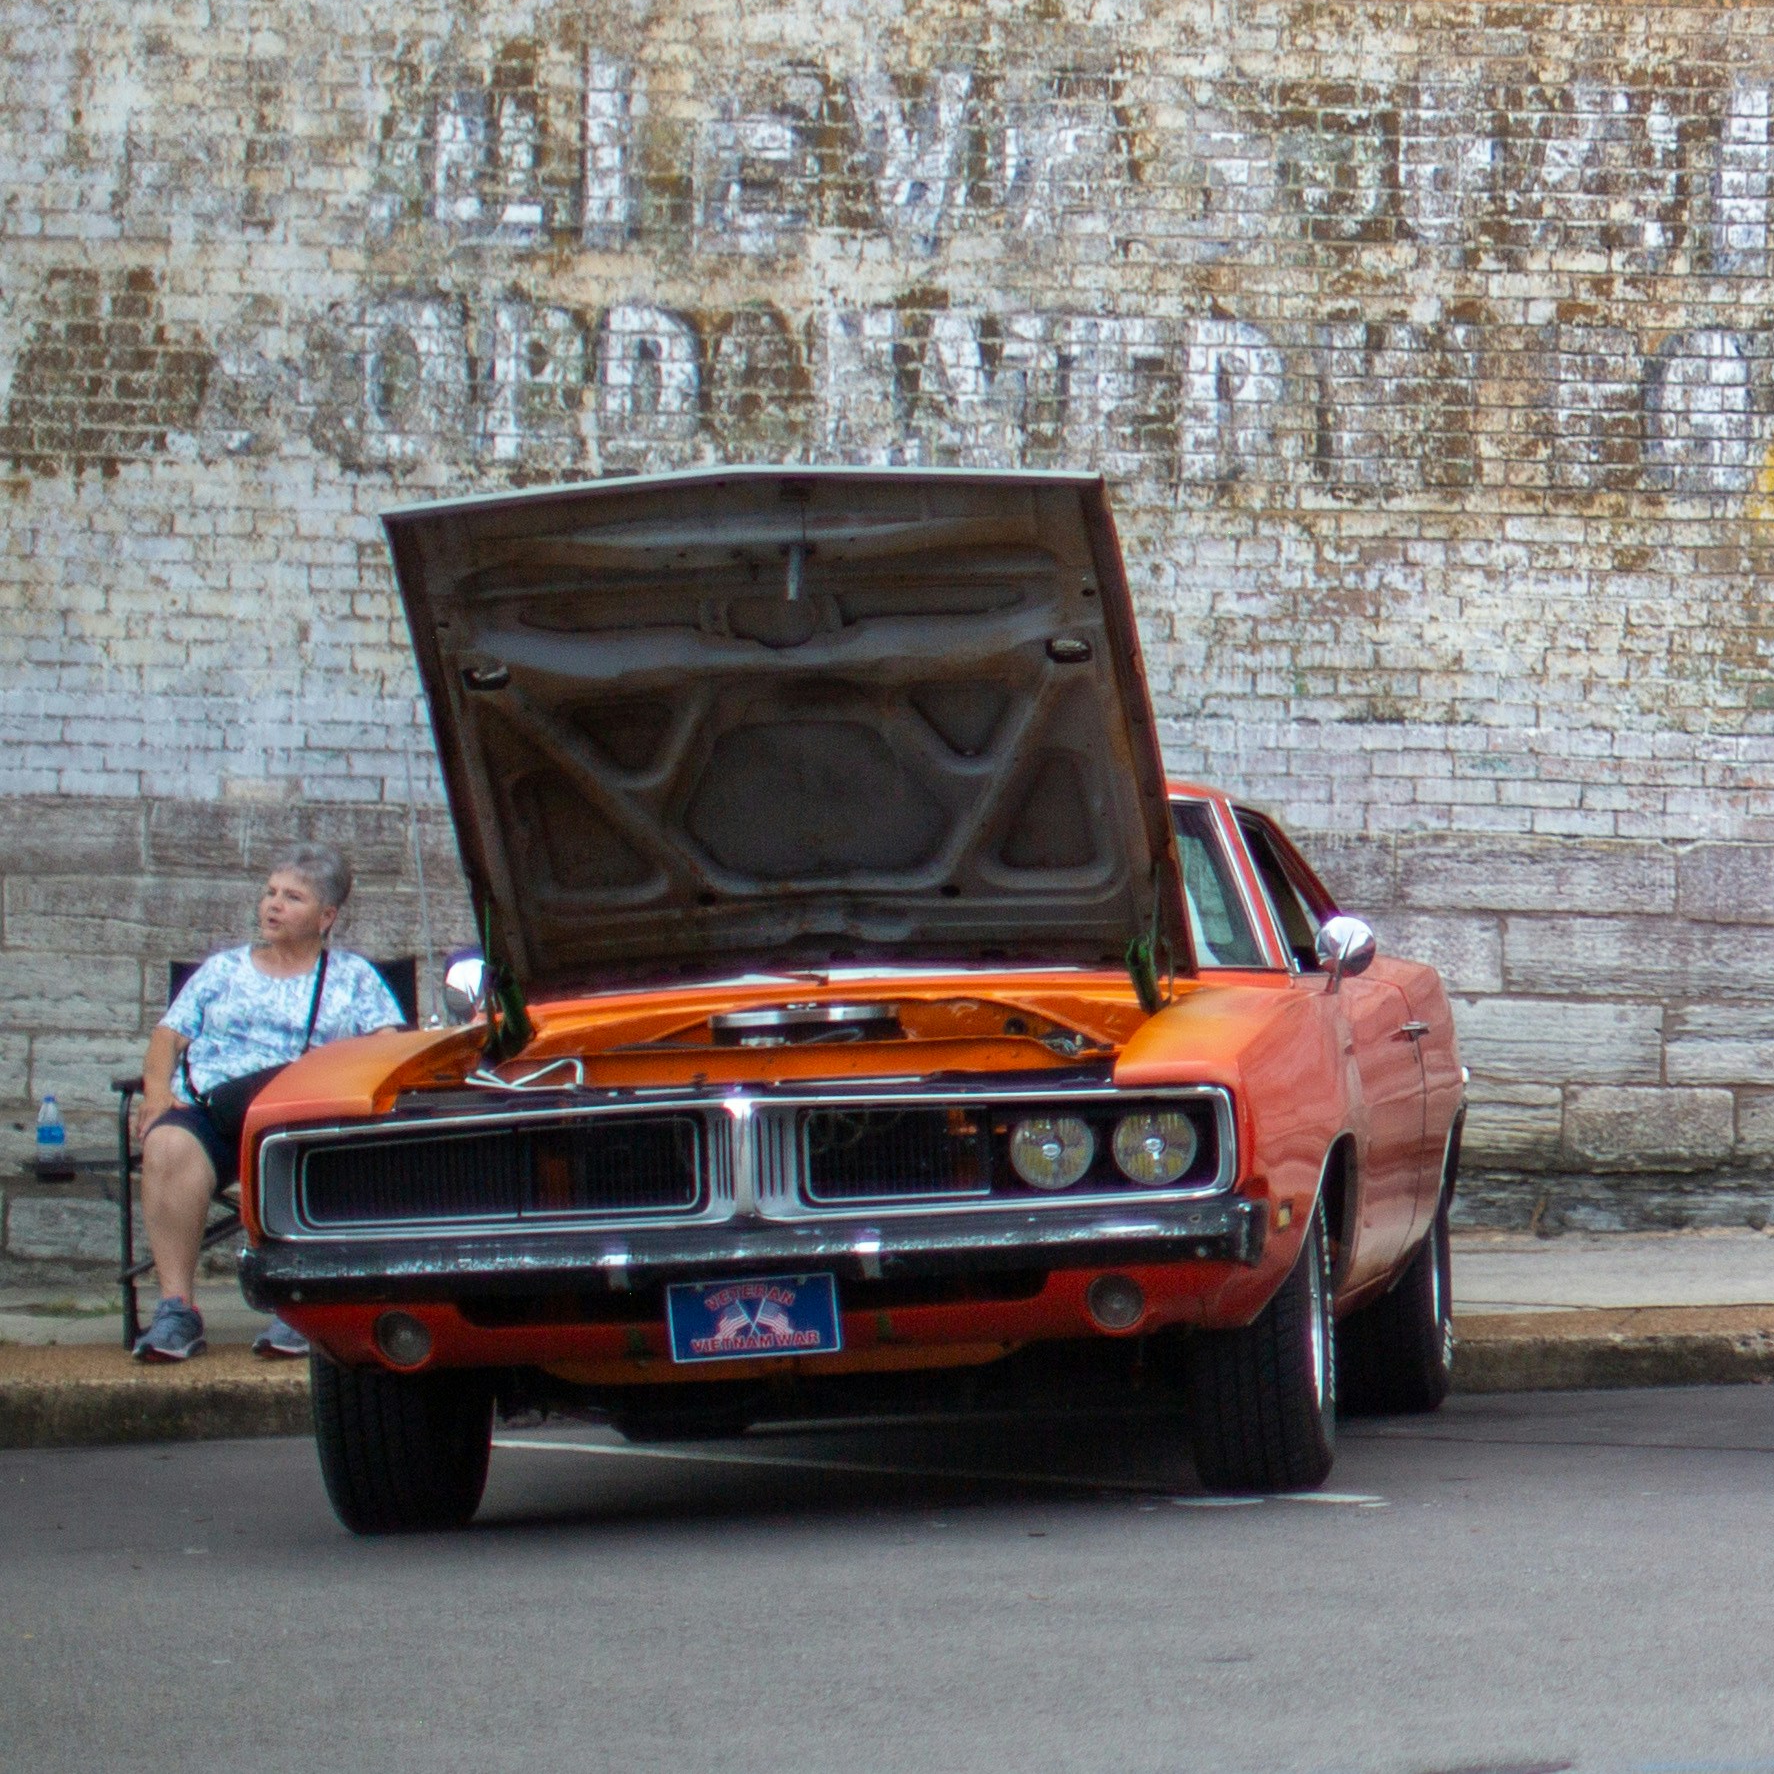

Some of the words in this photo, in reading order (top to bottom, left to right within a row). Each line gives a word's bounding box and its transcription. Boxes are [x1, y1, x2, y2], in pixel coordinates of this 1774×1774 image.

[704, 1283, 796, 1312] VETERAN
[690, 1331, 773, 1354] VIETNAM
[774, 1329, 820, 1346] WAR
